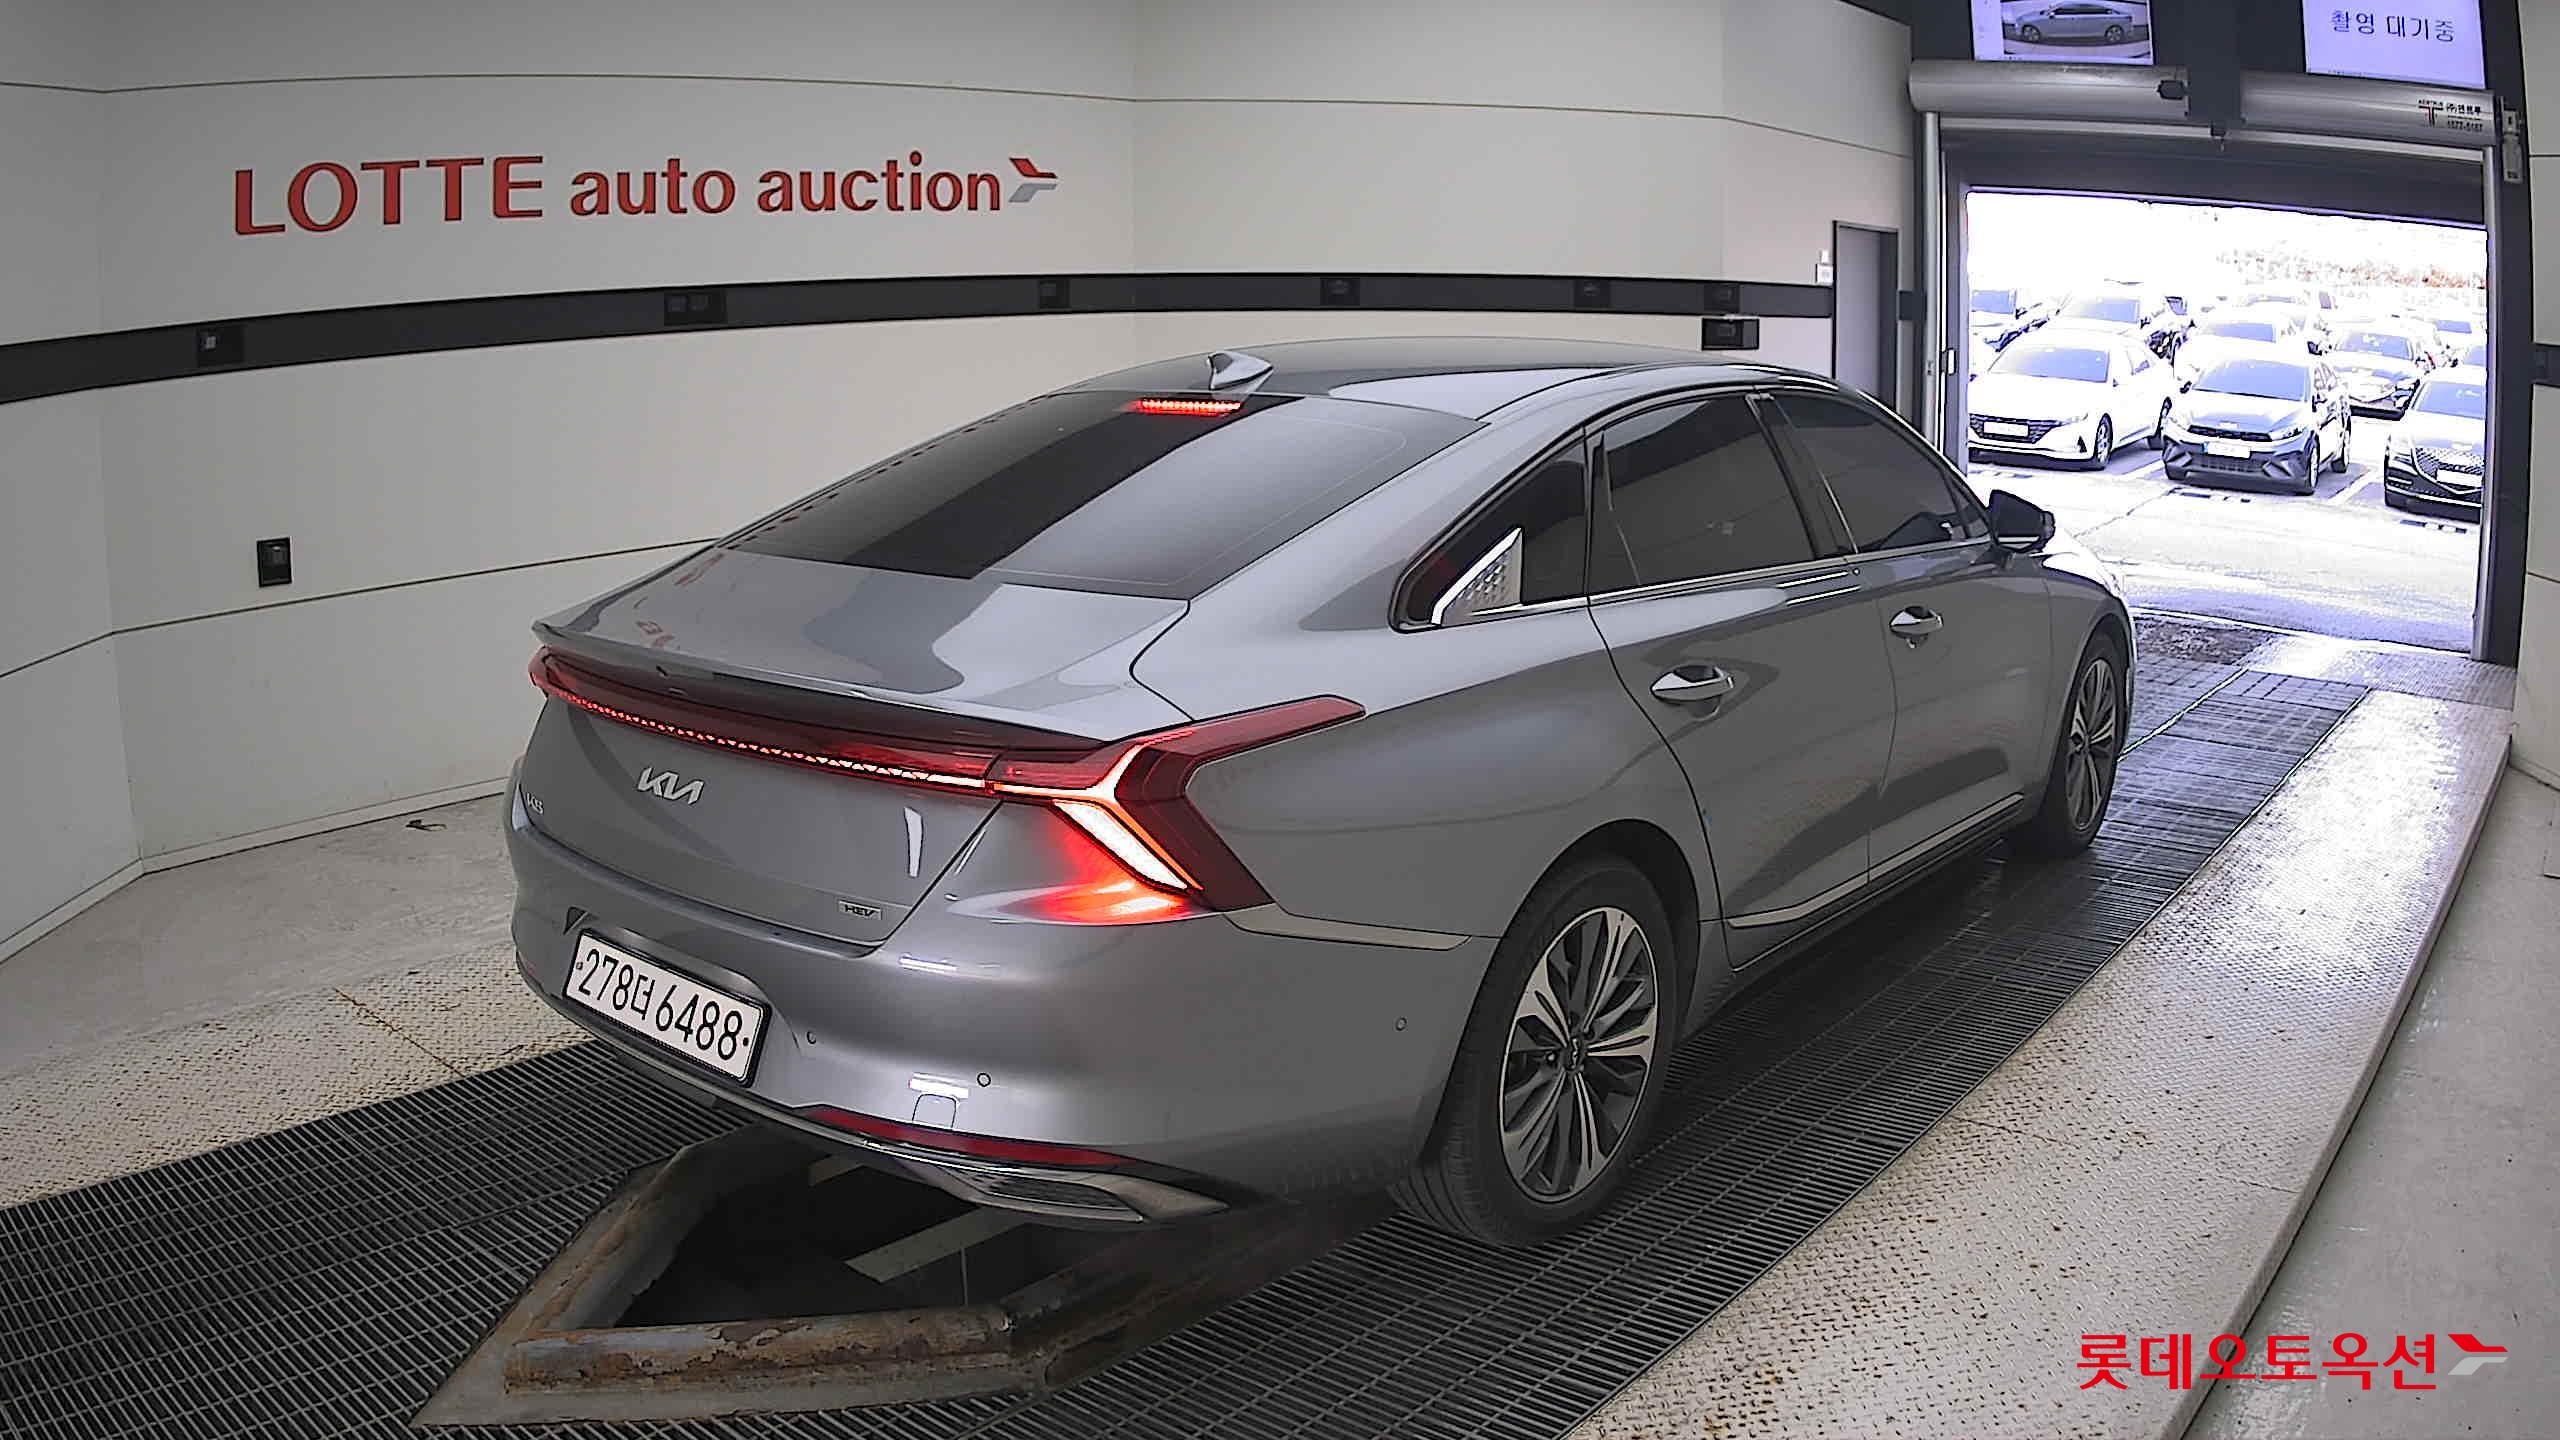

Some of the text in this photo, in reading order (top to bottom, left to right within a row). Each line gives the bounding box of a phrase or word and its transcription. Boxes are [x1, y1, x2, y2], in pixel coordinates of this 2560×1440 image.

[2331, 10, 2454, 42] 촬영 대기중
[235, 151, 1002, 236] LOTTE auto auction
[638, 767, 705, 805] KIA
